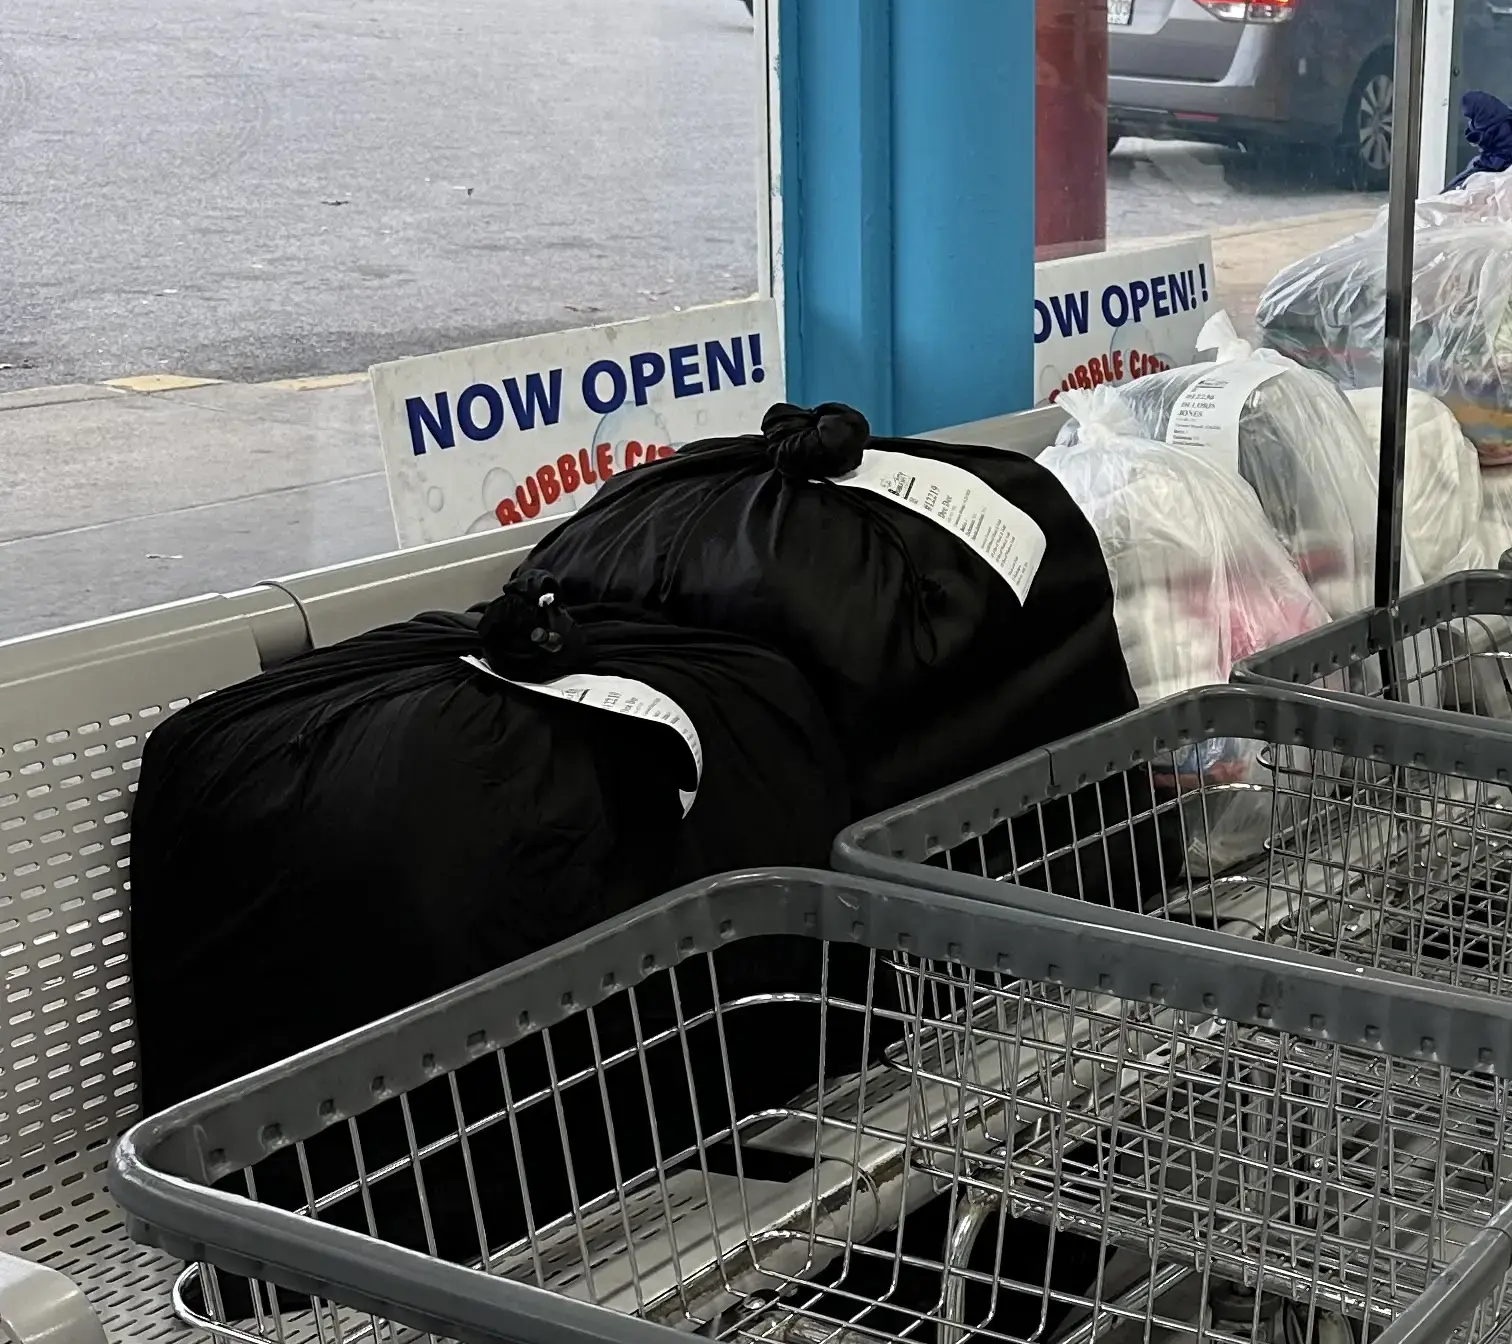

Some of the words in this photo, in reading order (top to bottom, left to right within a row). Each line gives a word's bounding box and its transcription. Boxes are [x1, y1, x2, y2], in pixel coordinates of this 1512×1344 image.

[1101, 263, 1209, 328] OPEN!!
[404, 368, 563, 457] NOW
[581, 332, 766, 414] OPEN!
